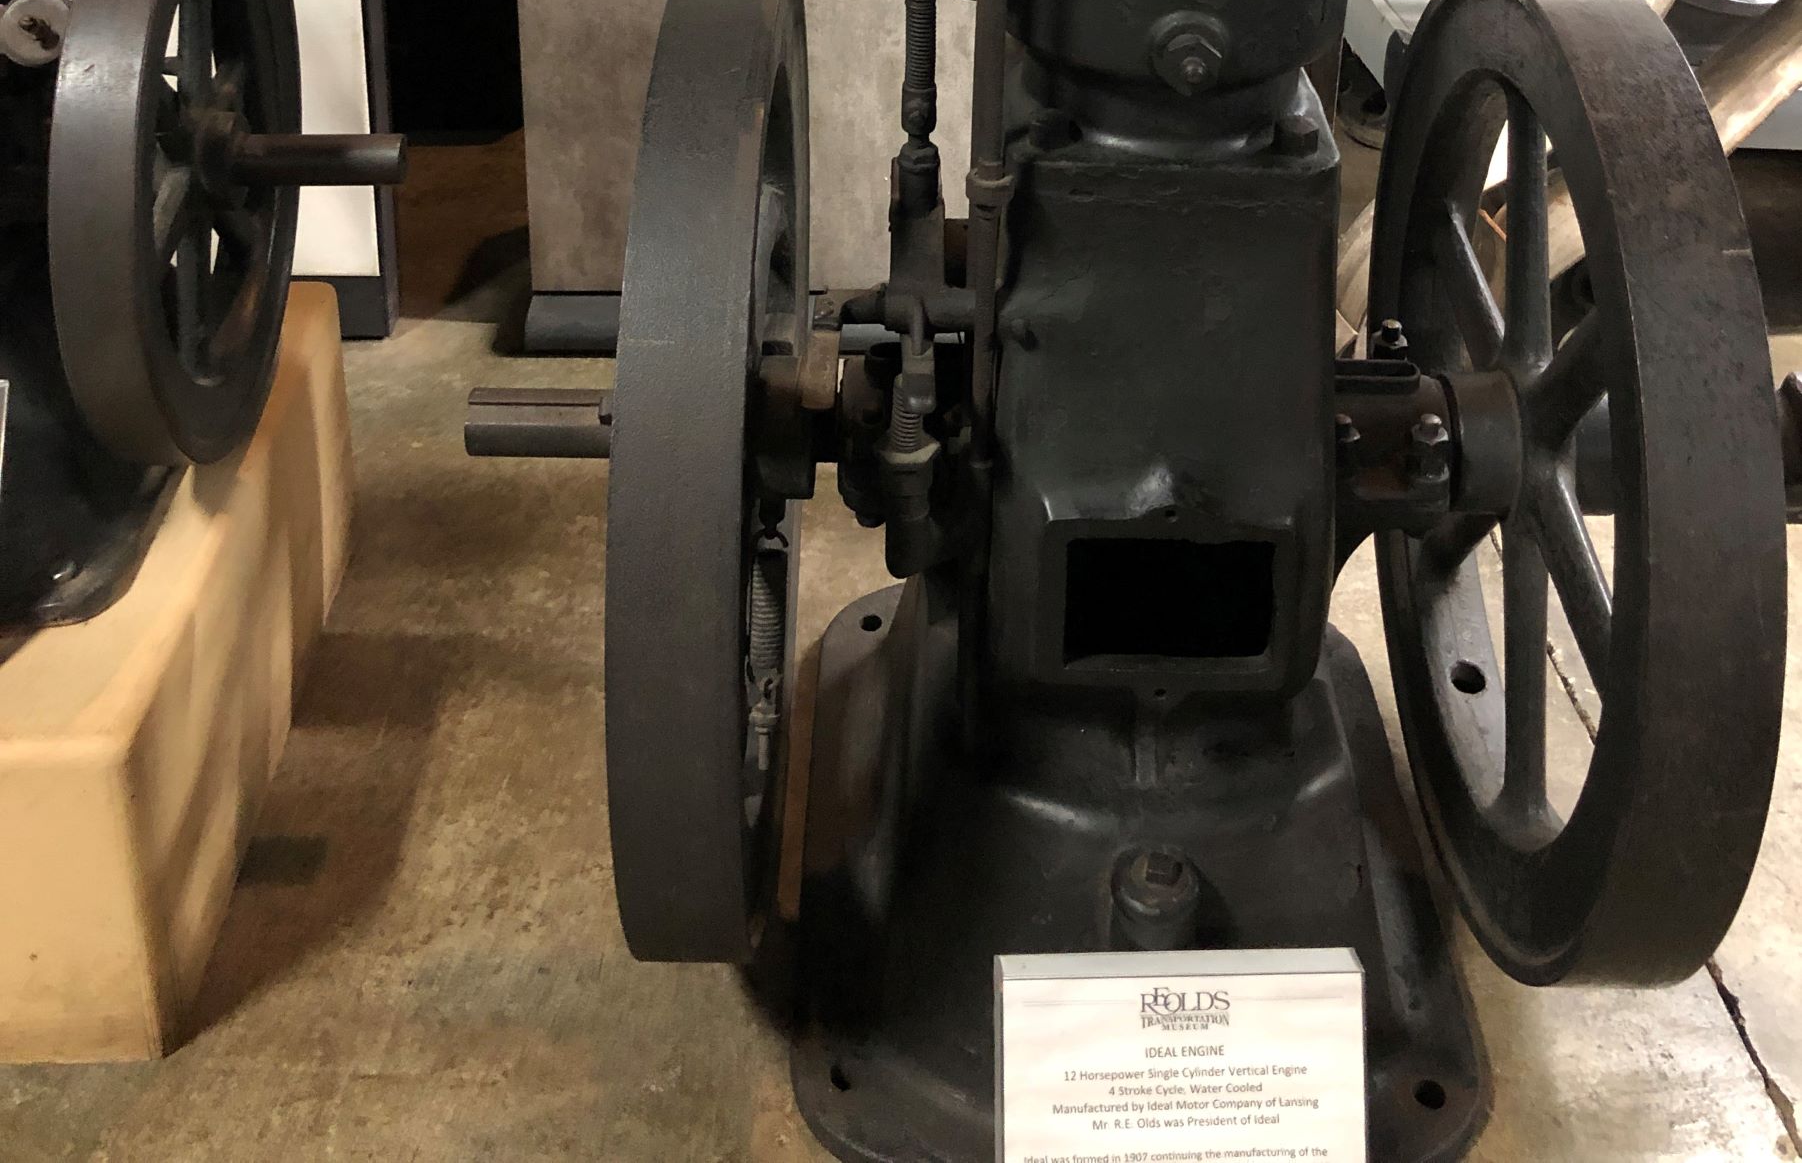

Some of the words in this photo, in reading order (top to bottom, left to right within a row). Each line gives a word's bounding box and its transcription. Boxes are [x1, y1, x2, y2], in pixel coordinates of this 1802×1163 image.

[1162, 1023, 1209, 1031] MUSEUM
[1144, 1046, 1178, 1058] IDEAL
[1180, 1044, 1224, 1057] ENGINE
[1064, 1070, 1076, 1081] 12
[1079, 1071, 1144, 1081] Horsepower
[1147, 1068, 1179, 1081] Single
[1181, 1067, 1225, 1079] Cylinder
[1228, 1065, 1269, 1076] Vertical
[1271, 1065, 1307, 1077] Engine
[1108, 1086, 1115, 1096] 4
[1118, 1085, 1152, 1095] Stroke
[1189, 1084, 1223, 1094] Water
[1225, 1082, 1263, 1093] Cooled
[1052, 1102, 1128, 1114] Manufactured
[1131, 1101, 1144, 1113] by
[1146, 1100, 1173, 1111] Ideal
[1175, 1100, 1210, 1109] Motor
[1211, 1098, 1262, 1109] Company
[1265, 1097, 1276, 1107] of
[1278, 1096, 1319, 1109] Lansing
[1136, 1117, 1161, 1128] Olds
[1163, 1118, 1184, 1127] was
[1187, 1116, 1237, 1126] President
[1240, 1114, 1251, 1125] of
[1253, 1113, 1280, 1124] Ideal
